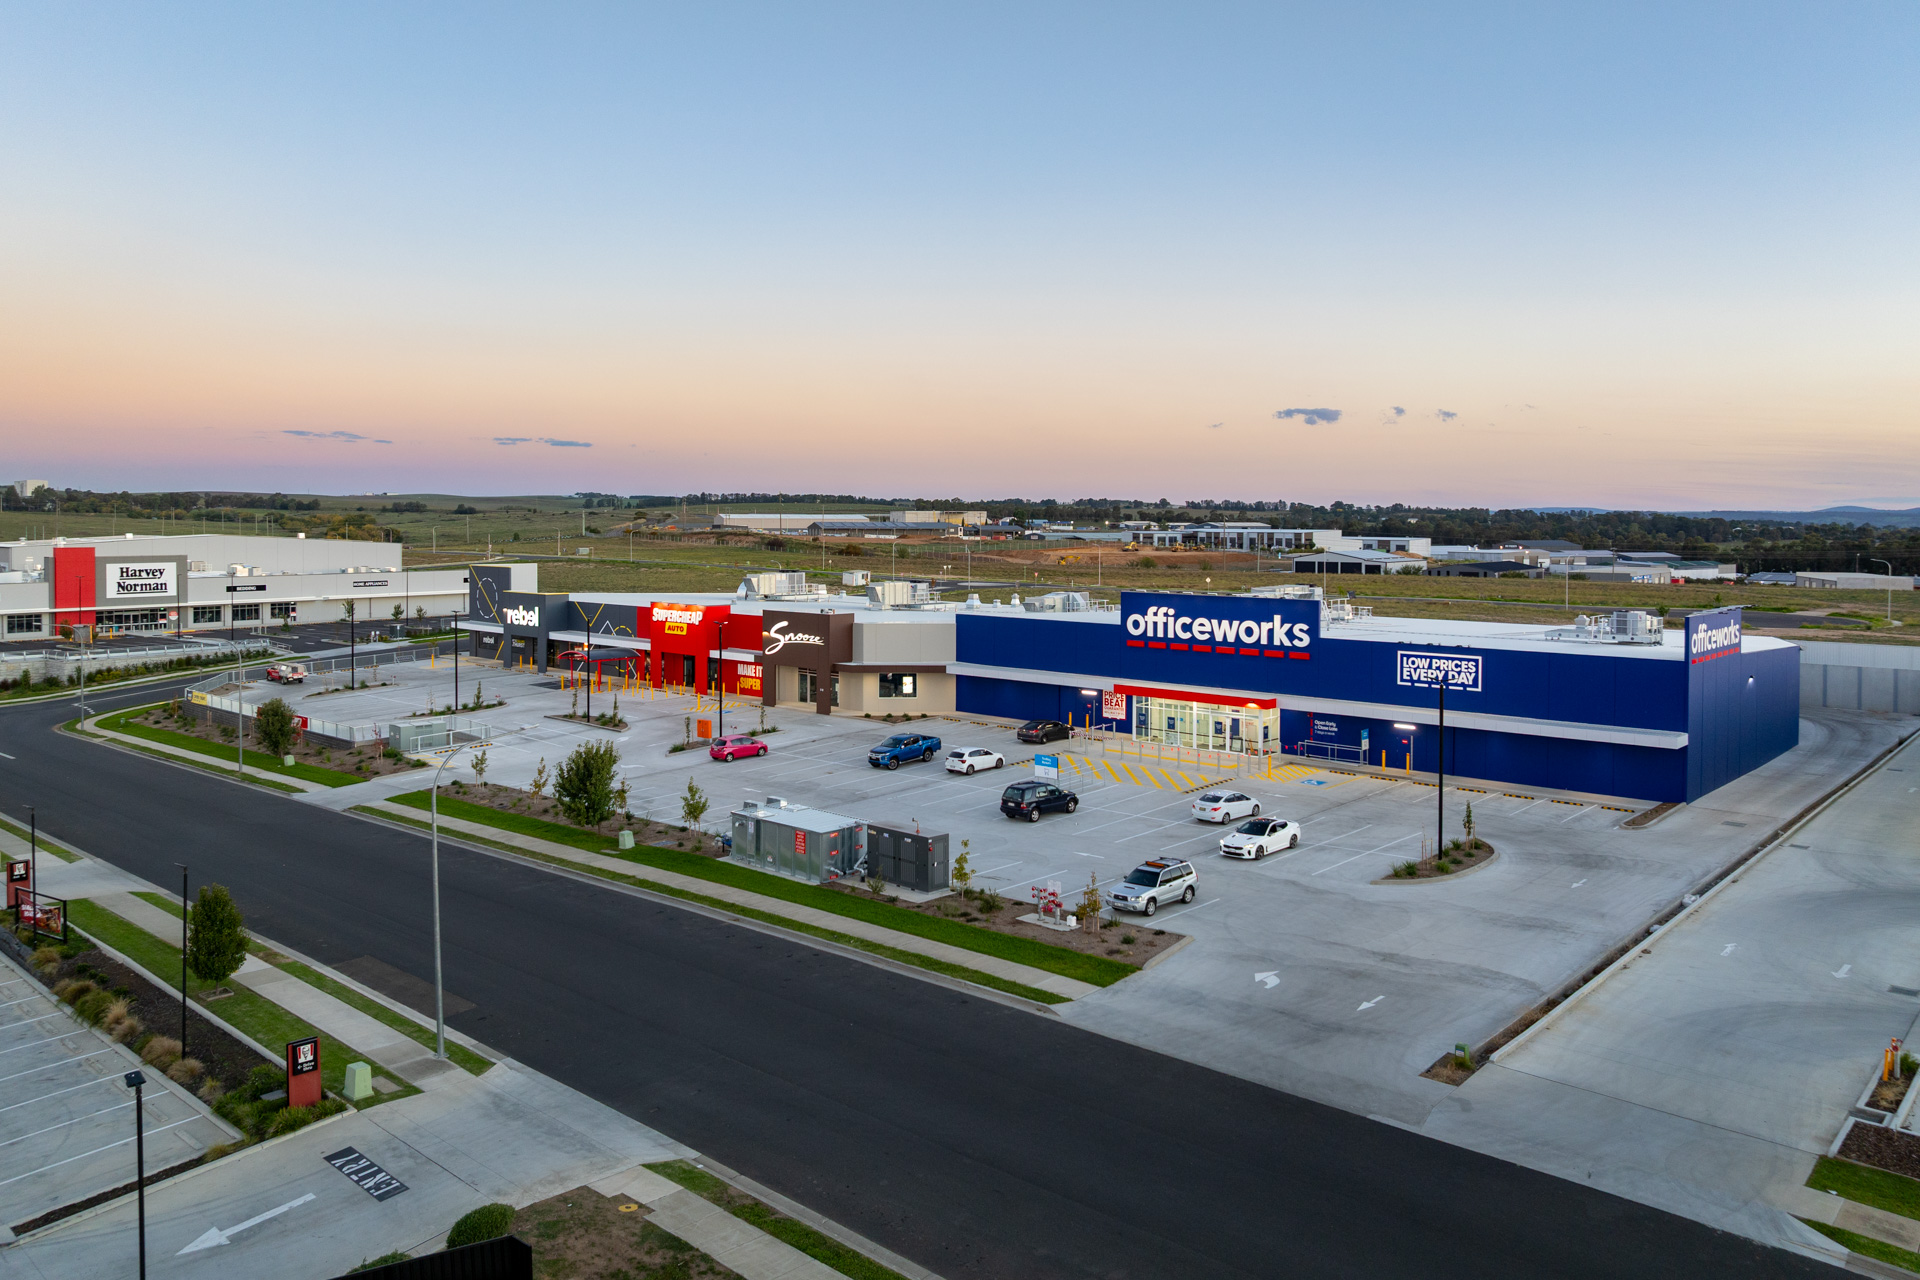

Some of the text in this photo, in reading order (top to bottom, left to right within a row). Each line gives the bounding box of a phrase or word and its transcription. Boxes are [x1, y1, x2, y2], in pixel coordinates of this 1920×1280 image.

[119, 566, 165, 580] Harvey
[116, 581, 168, 592] Norman
[506, 605, 540, 627] rebel
[652, 607, 703, 625] SUPERCHEAP
[1126, 606, 1311, 648] officeworks
[482, 636, 495, 645] rebel
[765, 620, 825, 655] Snooze
[1691, 619, 1740, 654] officeworks
[737, 663, 763, 678] MAKE IT
[1403, 656, 1476, 673] LOW PRICES
[740, 677, 761, 690] SUPER
[1403, 668, 1476, 685] EVERY DAY
[1104, 690, 1124, 699] PRICE
[1104, 698, 1124, 708] BEAT
[331, 1153, 401, 1196] ENTRY
